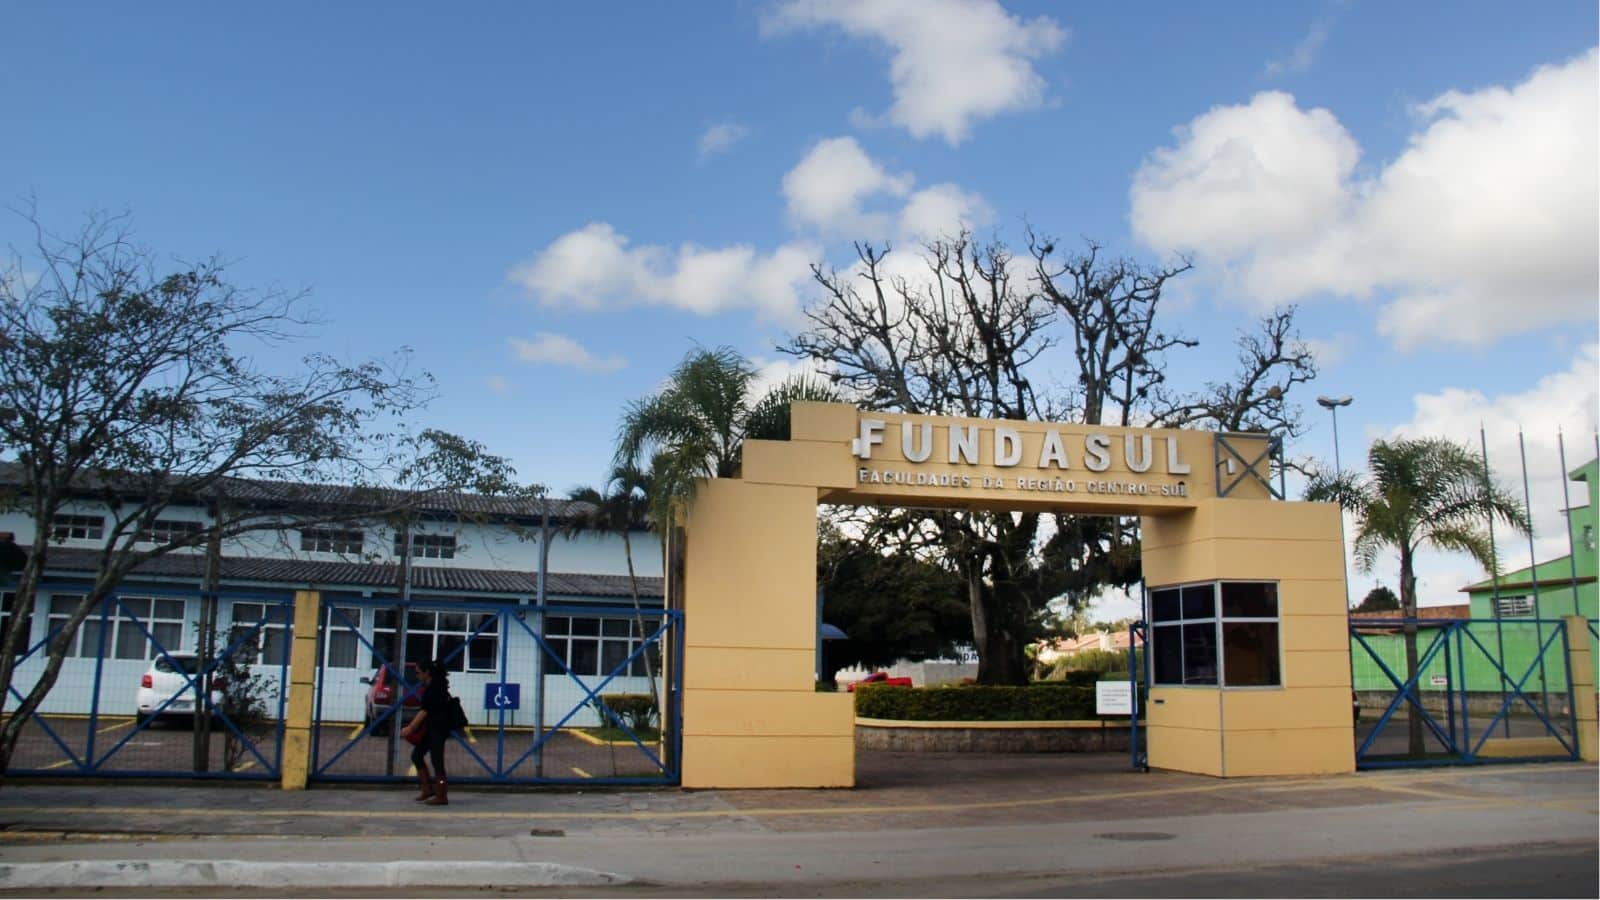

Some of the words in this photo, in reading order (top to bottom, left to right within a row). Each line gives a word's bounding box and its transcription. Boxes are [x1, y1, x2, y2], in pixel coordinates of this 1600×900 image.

[859, 418, 1192, 475] FUNDASUL
[859, 469, 970, 487] FACULDADES
[982, 476, 1004, 489] DA
[1017, 475, 1076, 492] REGIÃO
